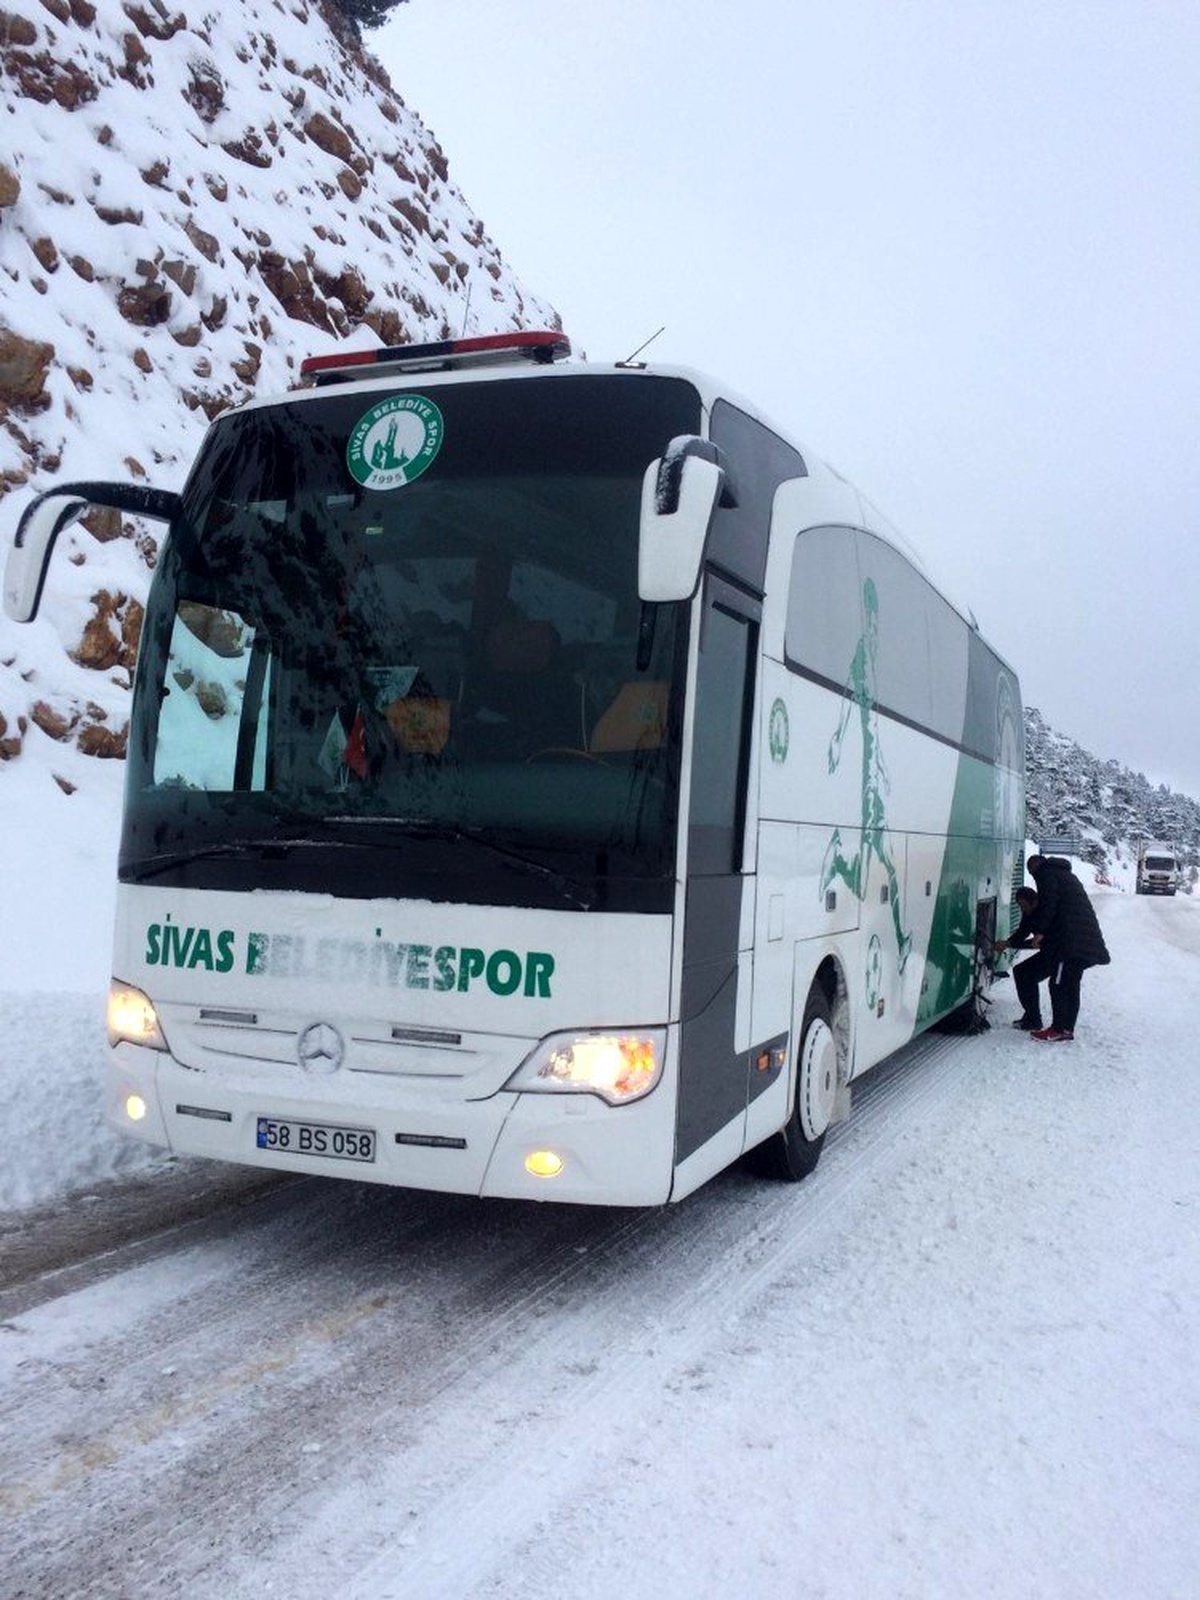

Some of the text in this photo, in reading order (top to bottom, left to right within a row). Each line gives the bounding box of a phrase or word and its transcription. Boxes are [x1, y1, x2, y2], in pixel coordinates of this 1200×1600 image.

[422, 420, 438, 456] SPOR
[145, 913, 235, 973] SİVAS
[267, 1124, 371, 1157] 58 BS 058
